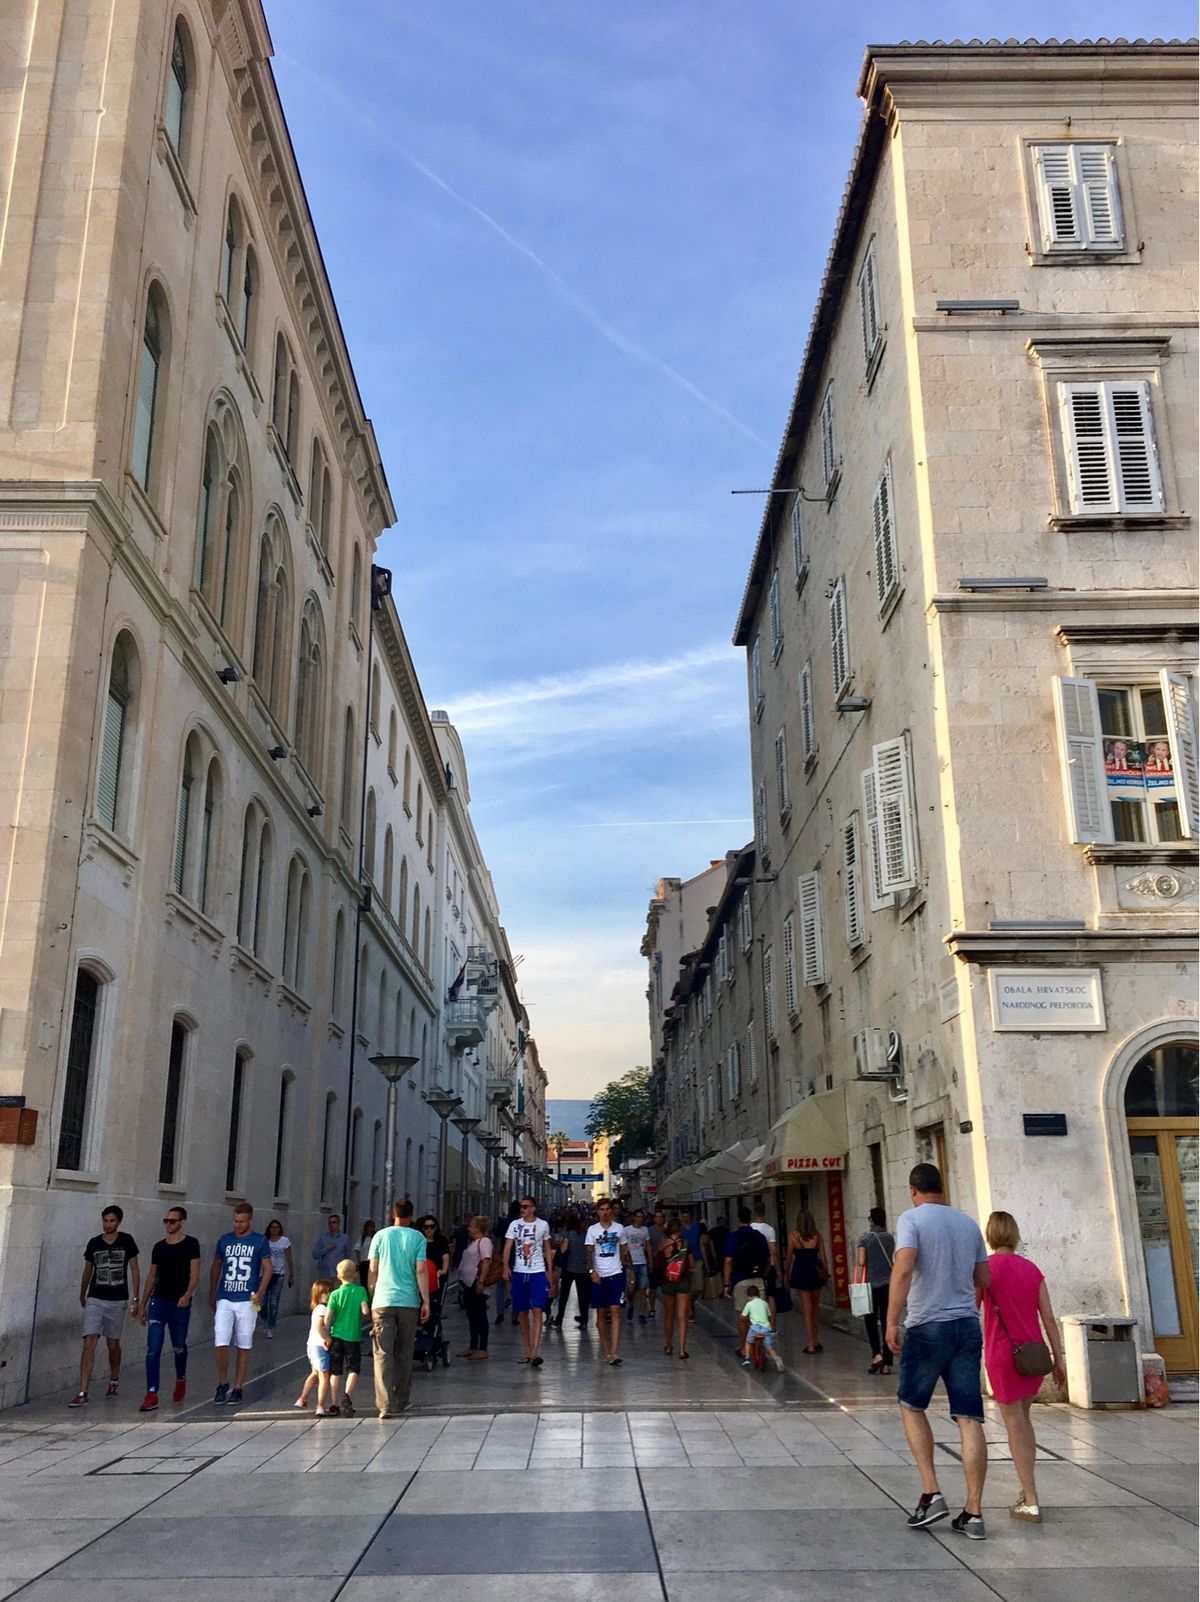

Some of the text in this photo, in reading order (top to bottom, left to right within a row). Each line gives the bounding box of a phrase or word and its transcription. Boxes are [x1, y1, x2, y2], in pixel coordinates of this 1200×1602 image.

[1003, 986, 1032, 994] OBALA
[1002, 1001, 1093, 1009] NARODNOG PREPORODA
[787, 1157, 819, 1169] PIZZA
[822, 1157, 842, 1168] CUT
[831, 1185, 843, 1243] PIZZA
[225, 1243, 255, 1257] BJÖRN
[225, 1256, 252, 1281] 35
[835, 1254, 845, 1288] CUT
